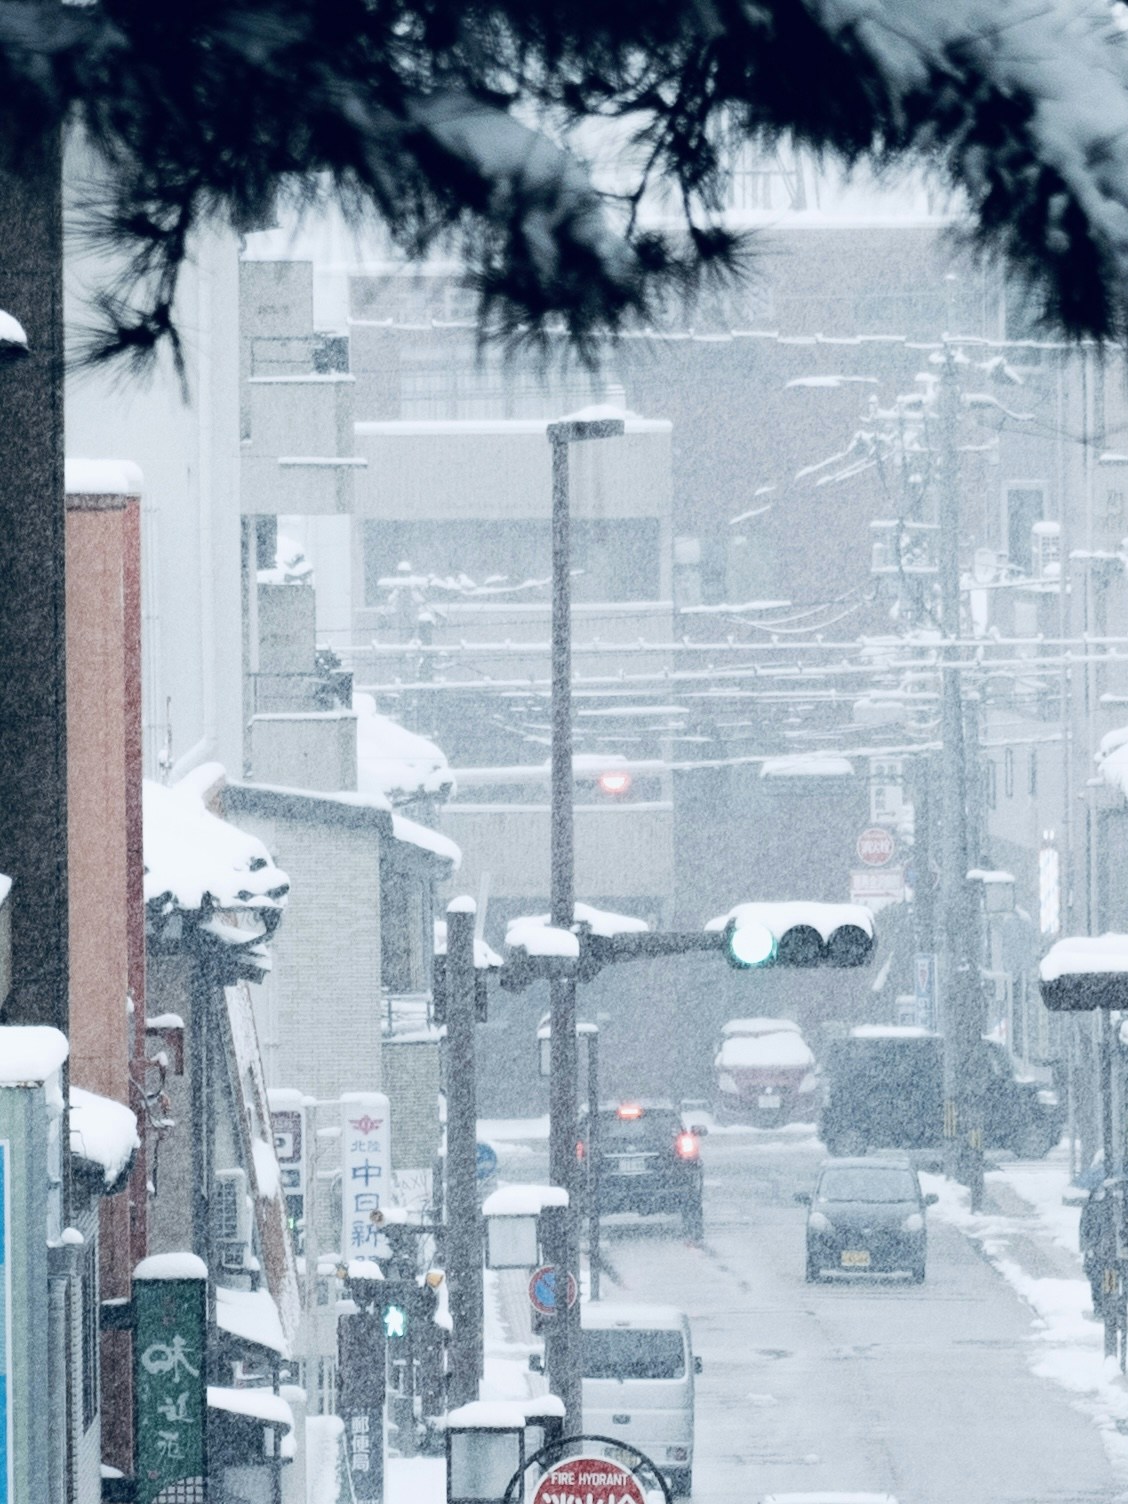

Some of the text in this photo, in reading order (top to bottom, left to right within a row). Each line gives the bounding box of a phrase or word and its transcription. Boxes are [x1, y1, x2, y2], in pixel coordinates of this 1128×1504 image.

[351, 1158, 383, 1262] 中日新
[351, 1415, 370, 1472] 郵便局
[550, 1472, 629, 1486] FIRE HYDRANT
